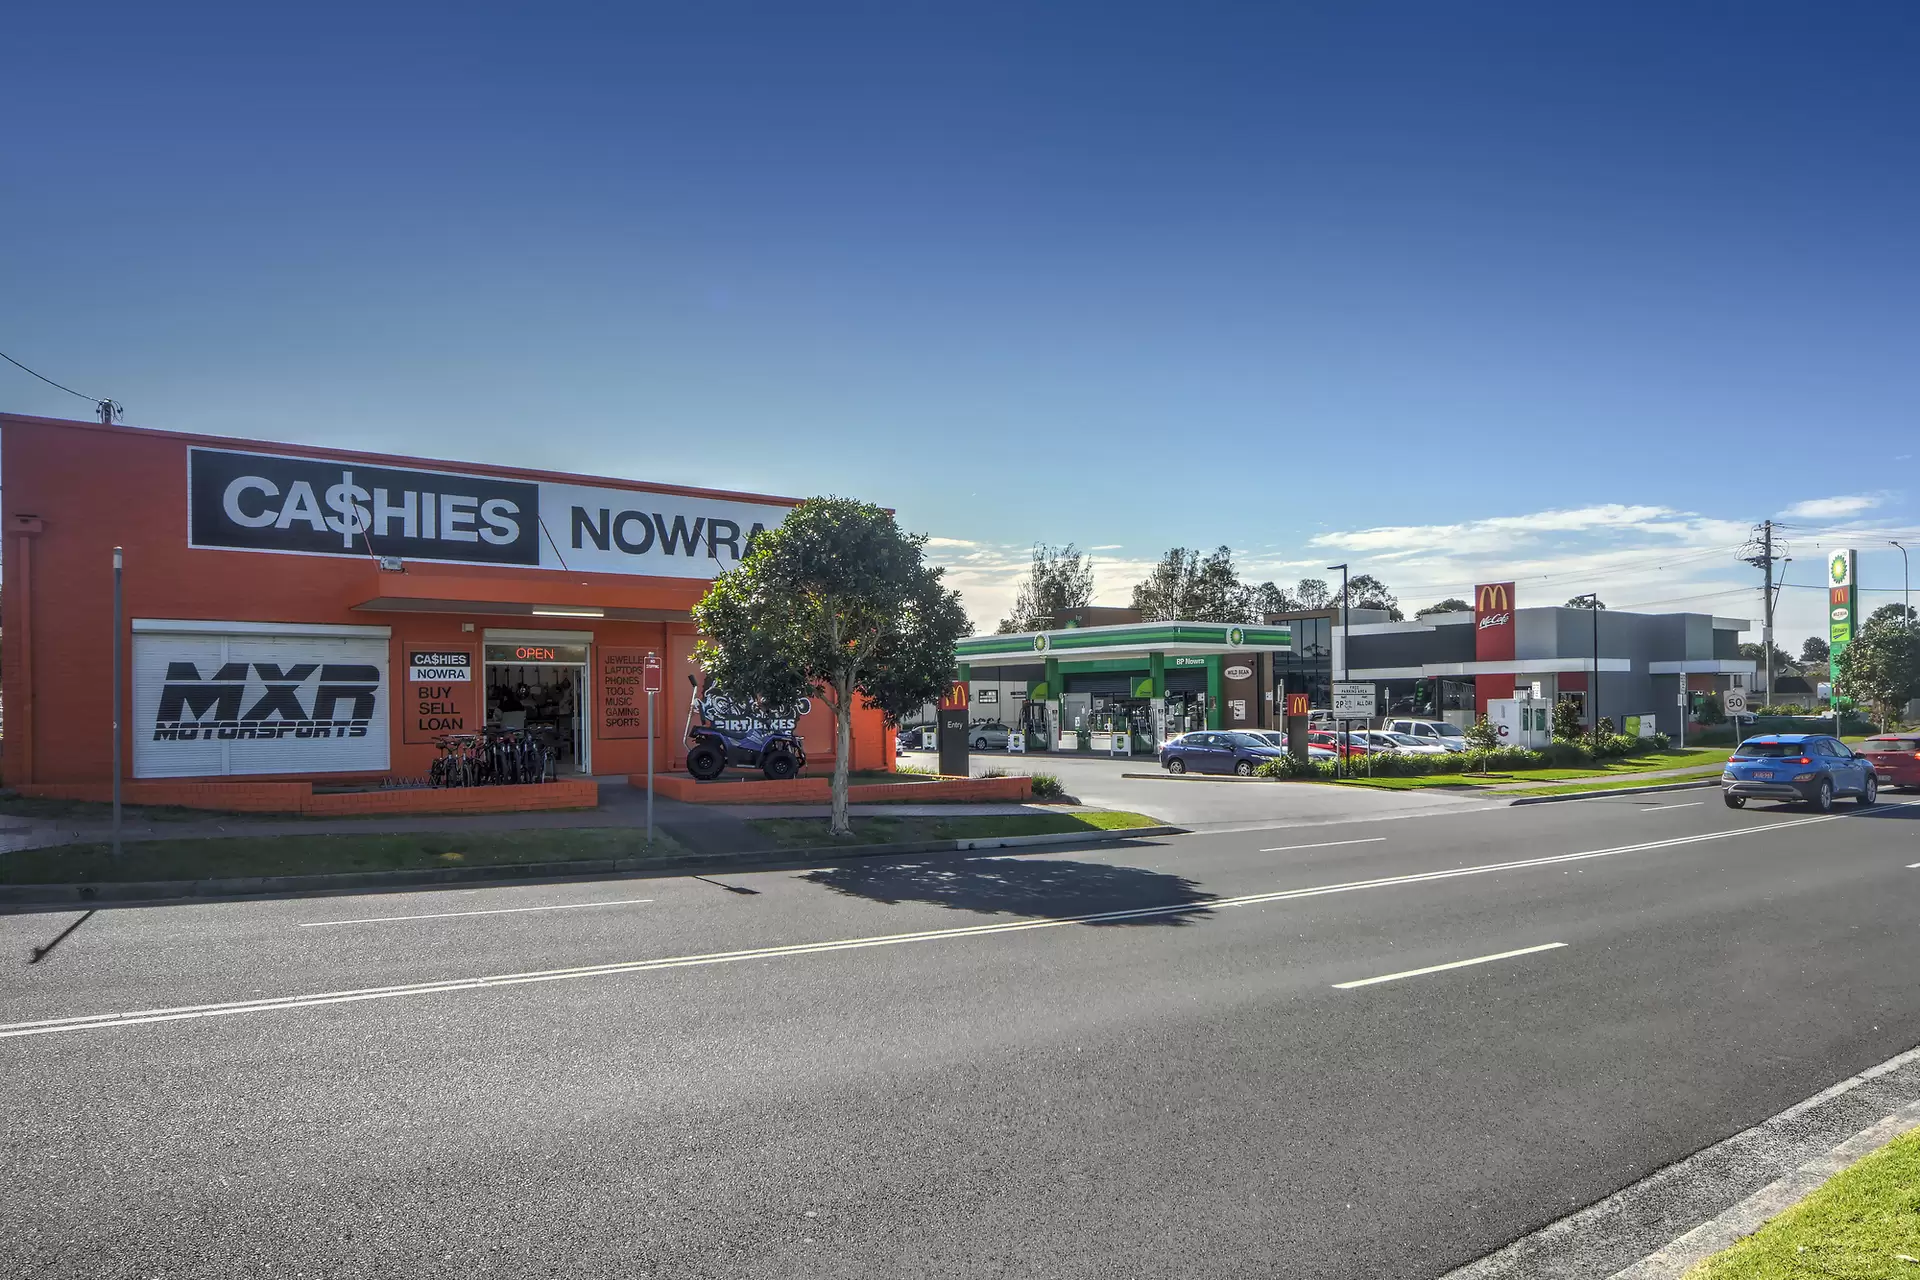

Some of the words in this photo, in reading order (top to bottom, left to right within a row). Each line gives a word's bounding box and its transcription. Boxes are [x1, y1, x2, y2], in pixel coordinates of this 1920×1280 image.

[223, 471, 520, 548] CA$HIES
[515, 647, 554, 660] OPEN
[414, 653, 467, 666] CA$HIES
[417, 669, 466, 679] NOWRA
[605, 666, 643, 675] LAPTOPS
[605, 676, 640, 685] PHONES
[156, 661, 380, 721] MXR
[418, 687, 452, 699] BUY
[605, 687, 634, 696] TOOLS
[605, 697, 632, 706] MUSIC
[1728, 698, 1743, 708] 50
[419, 702, 461, 715] SELL
[605, 708, 640, 717] GAMING
[419, 718, 463, 731] LOAN
[605, 717, 640, 727] SPORTS
[947, 721, 963, 730] Entry
[153, 720, 369, 741] MOTORSPORTS
